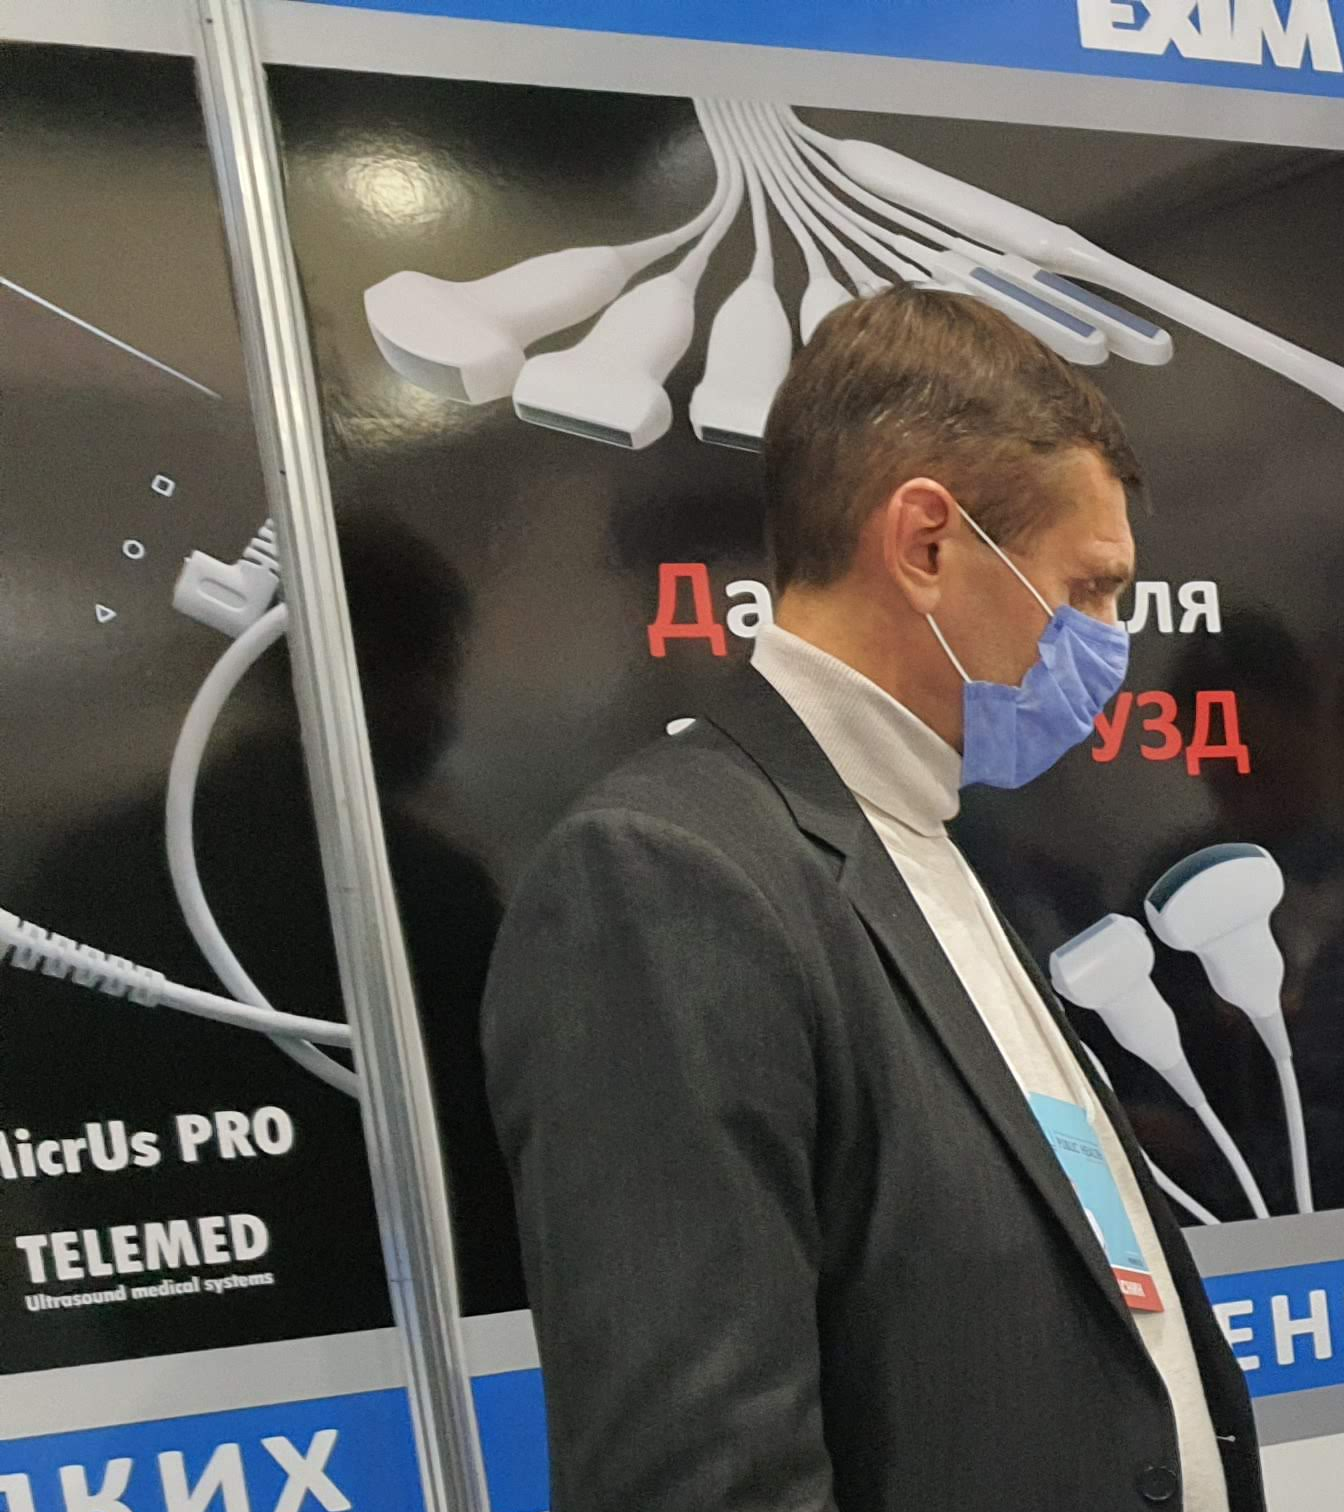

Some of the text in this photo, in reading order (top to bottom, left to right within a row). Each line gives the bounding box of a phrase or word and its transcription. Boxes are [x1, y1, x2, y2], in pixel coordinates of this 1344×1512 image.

[1115, 580, 1222, 634] ля
[1091, 691, 1251, 776] УЗД
[175, 1105, 295, 1162] PRO
[15, 1212, 270, 1284] TELEMED
[26, 1269, 274, 1312] Ultrasound medical systems
